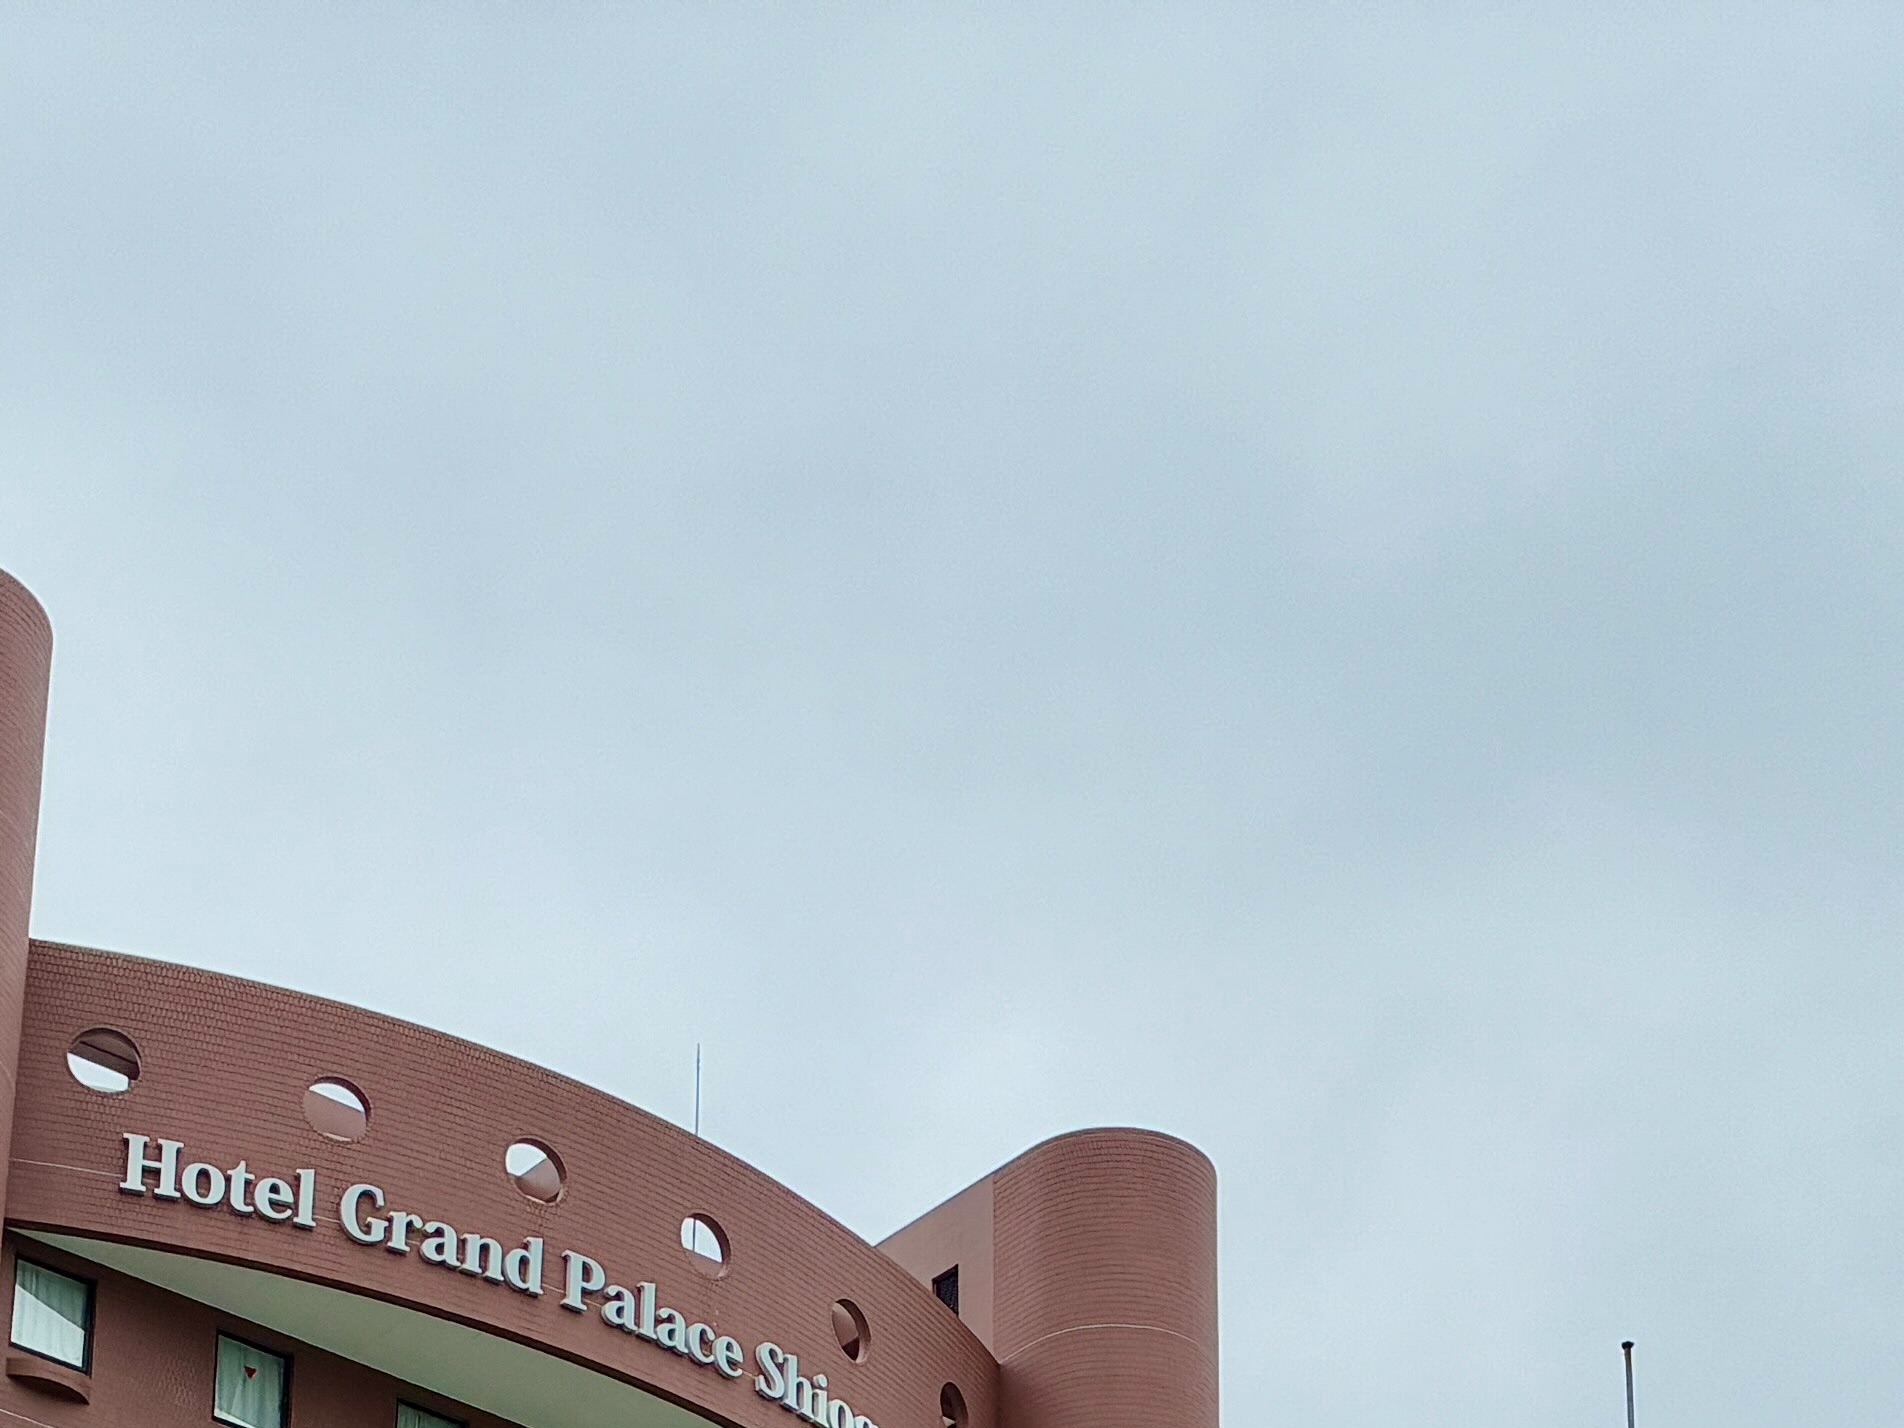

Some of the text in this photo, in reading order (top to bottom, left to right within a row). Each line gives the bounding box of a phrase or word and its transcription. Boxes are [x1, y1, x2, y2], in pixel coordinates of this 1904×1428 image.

[118, 1131, 317, 1229] Hotel
[339, 1184, 544, 1297] Grand
[560, 1249, 744, 1380] Palace
